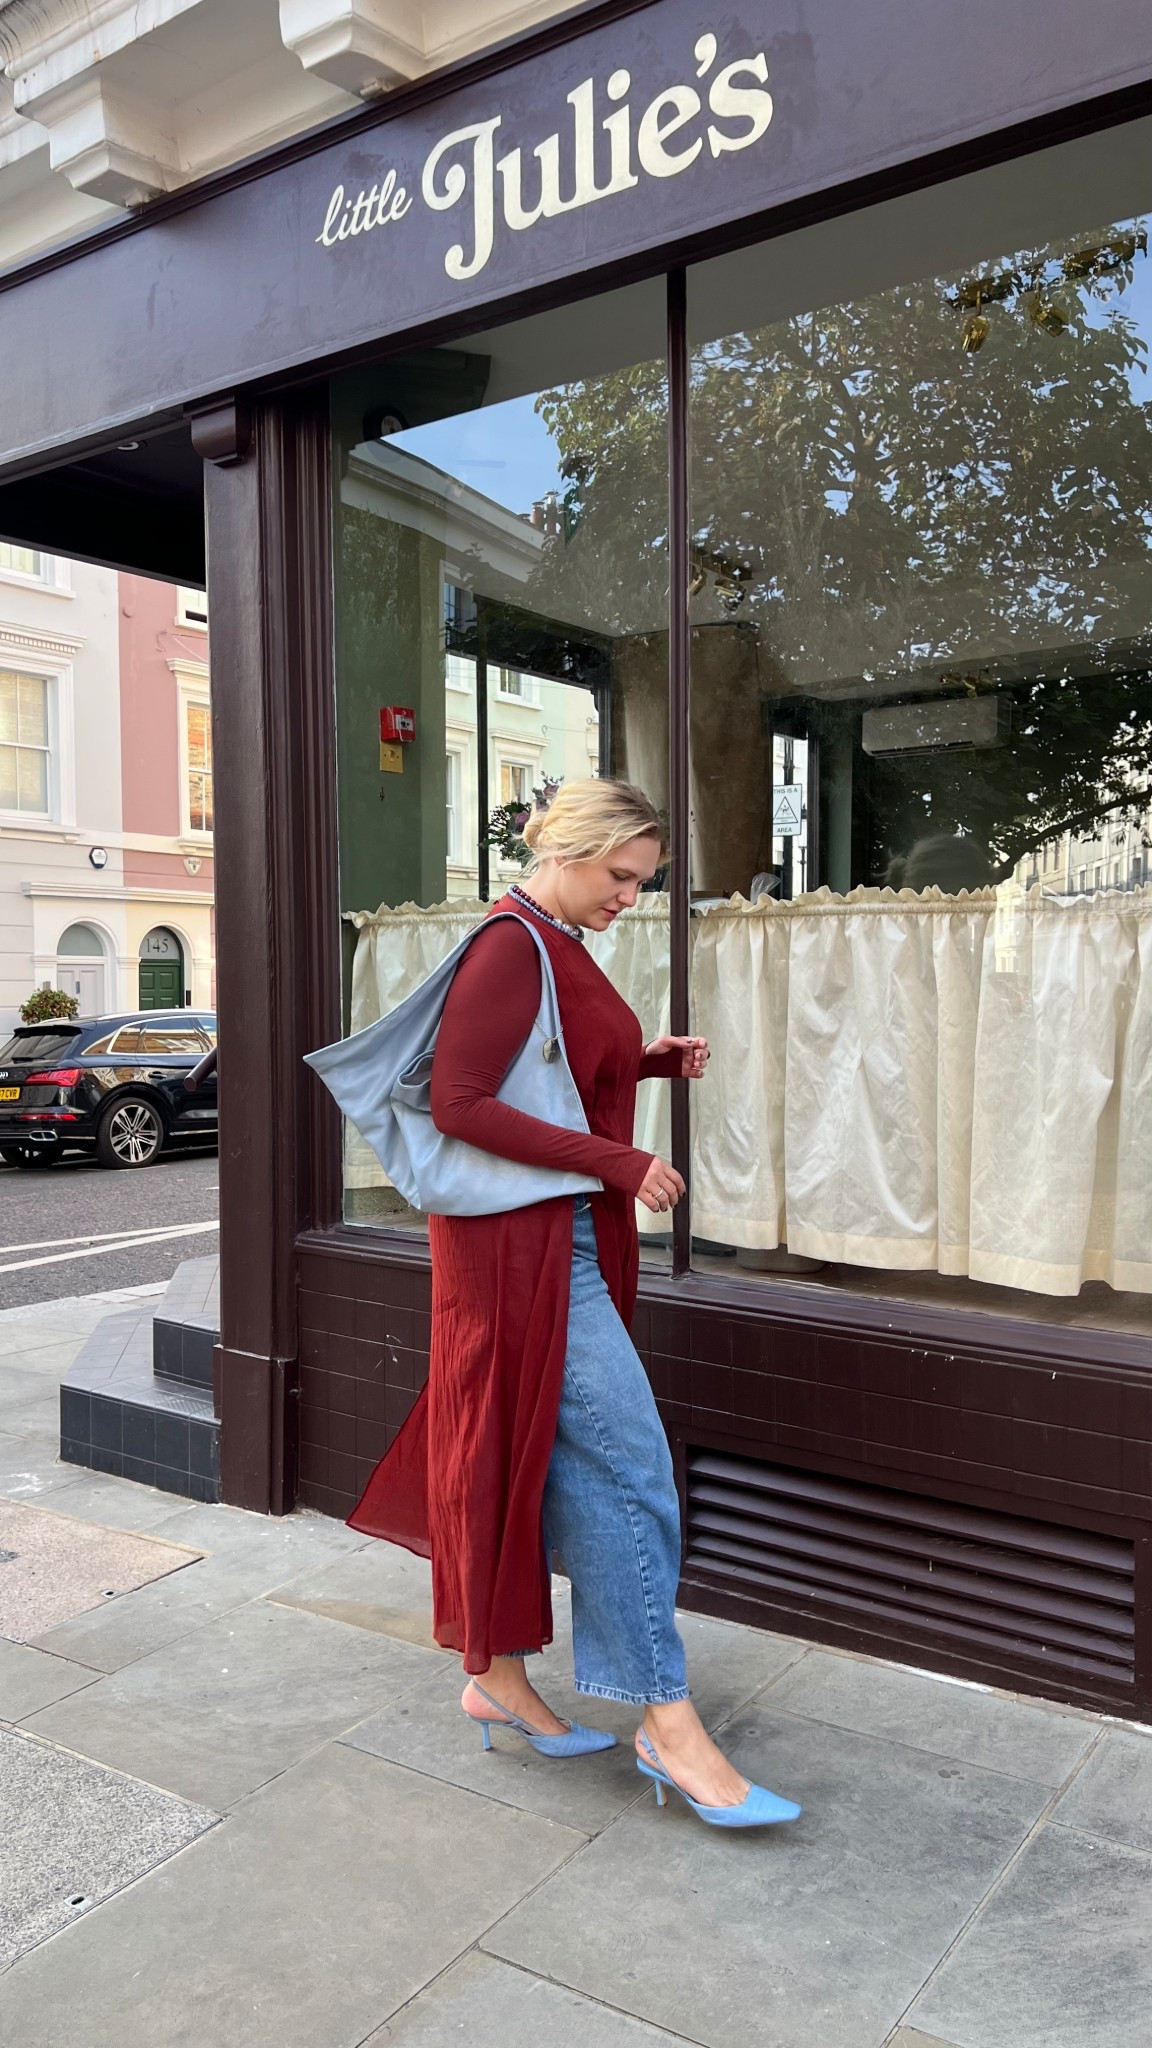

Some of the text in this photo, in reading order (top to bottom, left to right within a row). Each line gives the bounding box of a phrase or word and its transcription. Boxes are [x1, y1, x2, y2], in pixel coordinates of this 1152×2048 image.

[314, 33, 773, 280] little Julie's
[146, 938, 169, 953] 145
